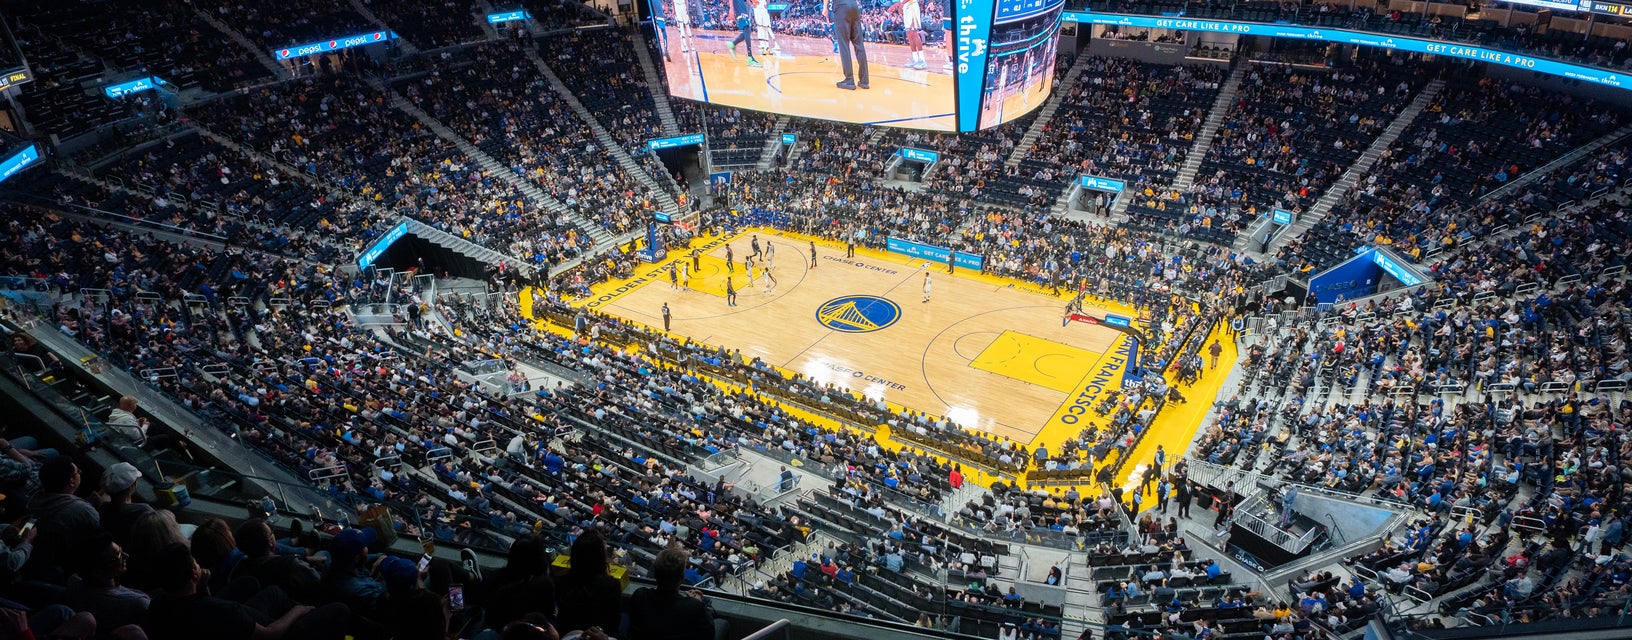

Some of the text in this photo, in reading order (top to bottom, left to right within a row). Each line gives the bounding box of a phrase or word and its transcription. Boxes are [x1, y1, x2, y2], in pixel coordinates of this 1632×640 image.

[298, 44, 322, 56] pepsi
[345, 36, 367, 47] pepsi
[958, 16, 977, 74] thrive
[1426, 44, 1446, 52] GET
[1450, 47, 1477, 56] CARE
[1480, 51, 1501, 61] LIKE
[1515, 58, 1535, 67] PRO
[10, 73, 26, 82] FINAL
[1601, 77, 1620, 86] thrive
[823, 255, 898, 275] CHASE CENTER
[587, 277, 648, 307] GOLDEN
[1114, 336, 1132, 356] SAN
[864, 375, 906, 391] CENTER
[1061, 356, 1125, 425] FRANCISCO
[1235, 554, 1257, 568] CHASE
